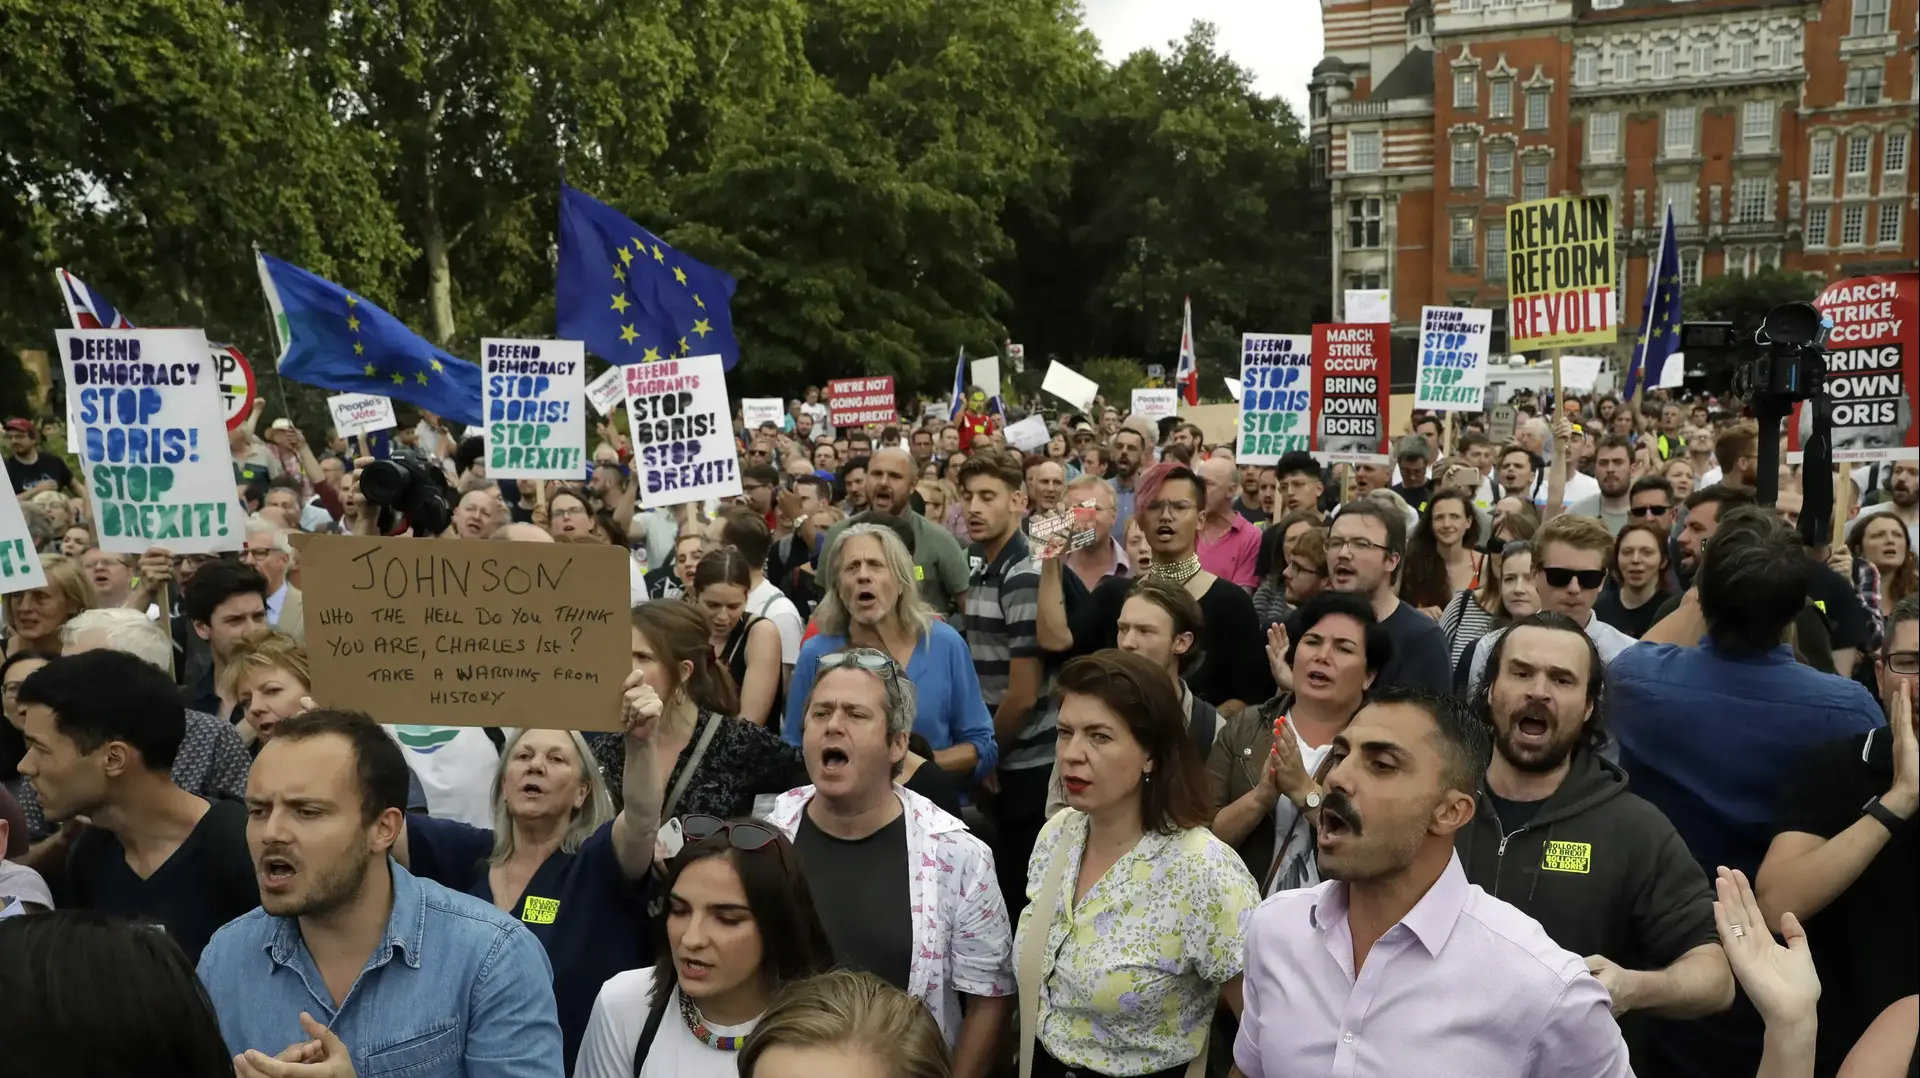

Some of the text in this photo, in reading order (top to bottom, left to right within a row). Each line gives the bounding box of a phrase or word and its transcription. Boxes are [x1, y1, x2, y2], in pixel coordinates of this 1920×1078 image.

[1511, 198, 1608, 251] REMAIN
[1512, 241, 1610, 295] REFORM
[1820, 281, 1899, 306] MARCH,
[1427, 310, 1463, 321] DEFEND
[1513, 286, 1610, 340] REVOLT
[1821, 301, 1895, 323] STRIKE,
[1327, 329, 1375, 343] MARCH,
[1425, 321, 1485, 334] DEMOCRACY
[1829, 319, 1902, 342] CCUPY
[70, 337, 141, 361] DEFEND
[488, 344, 540, 359] DEFEND
[1245, 339, 1292, 352] DEFEND
[1329, 344, 1373, 357] STRIKE,
[1424, 332, 1466, 350] STOP
[488, 359, 576, 375] DEMOCRACY
[1324, 358, 1377, 371] OCCUPY
[1422, 350, 1478, 368] BORIS!
[74, 363, 200, 386] DEMOCRACY
[626, 361, 678, 381] DEFEND
[1243, 367, 1299, 388] STOP
[1421, 367, 1463, 385] STOP
[488, 375, 549, 398] STOP
[834, 379, 888, 393] WE'RE NOT
[1325, 377, 1377, 393] BRING
[1420, 385, 1481, 403] BREXIT!
[80, 387, 162, 425] STOP
[490, 399, 569, 423] BORIS!
[634, 392, 692, 421] STOP
[830, 396, 863, 409] GOING
[1324, 398, 1377, 414] DOWN
[351, 409, 377, 421] Vote
[833, 409, 895, 425] STOP BREXIT
[1243, 412, 1298, 433] STOP
[1832, 402, 1896, 425] ORIS
[490, 423, 550, 446] STOP
[638, 412, 716, 444] BORIS!
[1326, 419, 1375, 435] BORIS
[86, 427, 199, 464] BORIS!
[643, 440, 701, 467] STOP
[491, 446, 580, 469] BREXIT!
[93, 464, 174, 502] STOP
[647, 459, 733, 493] BREXIT!
[102, 502, 228, 539] BREXIT!
[352, 546, 572, 599] JOHNSON
[319, 608, 353, 626] WHO
[371, 608, 406, 624] THE
[425, 607, 464, 625] HELL
[554, 605, 614, 624] THINK
[327, 637, 364, 656] YOU
[374, 637, 426, 660] ARE,
[436, 635, 525, 654] CHARLES
[367, 668, 415, 682] TAKE
[434, 669, 444, 681] A
[554, 668, 599, 683] FROM
[430, 691, 505, 705] HISTORY
[1546, 855, 1586, 865] BOLLOCKS
[1560, 849, 1586, 857] BREXIT
[1560, 861, 1583, 871] BORIS
